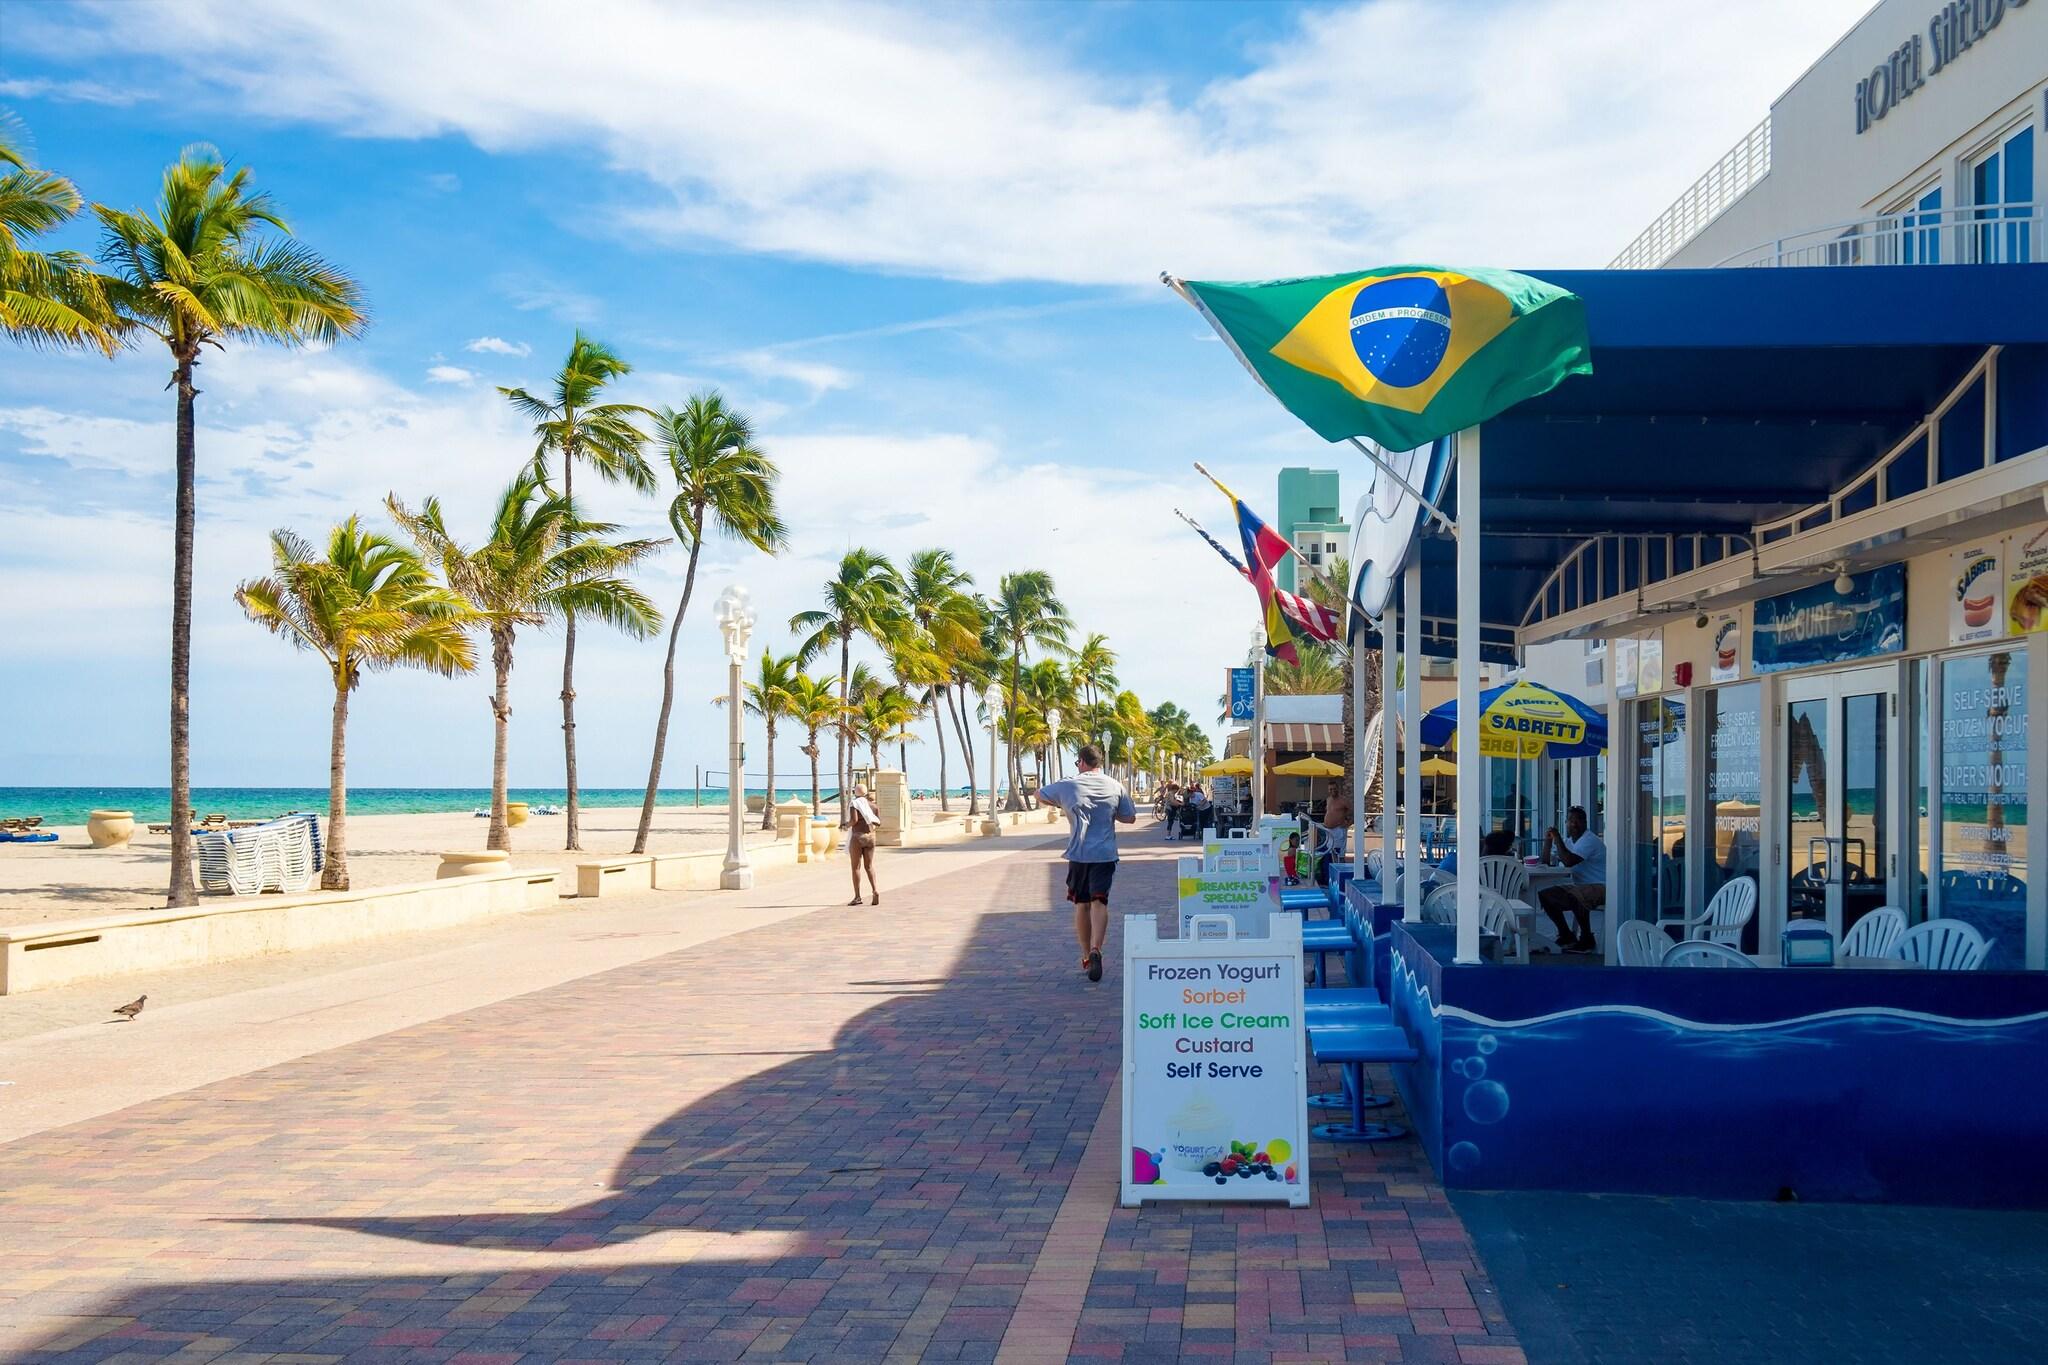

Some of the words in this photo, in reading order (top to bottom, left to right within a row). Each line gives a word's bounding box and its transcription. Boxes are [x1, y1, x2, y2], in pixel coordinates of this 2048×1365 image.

[1855, 34, 1925, 135] HOTEL
[1928, 0, 2028, 76] SHELD
[1352, 311, 1386, 326] ORDEM
[1397, 309, 1448, 325] PROGRESSO
[1956, 557, 1996, 602] SABRETT
[1505, 698, 1559, 707] SABRETT
[1953, 686, 2022, 712] SELF-SERVE
[1491, 714, 1580, 739] SABRETT
[1943, 718, 1986, 738] FROZEN
[1711, 733, 1736, 748] FROZEN
[1709, 772, 1730, 788] SUPER
[1943, 766, 1977, 787] SUPER
[1716, 816, 1740, 832] PROTEIN
[1742, 816, 1758, 832] BARS
[1960, 827, 1990, 840] PROTEIN
[1991, 828, 2012, 841] BARS
[1197, 881, 1263, 892] BREAKFAST
[1203, 892, 1258, 903] SPECIALS
[1149, 965, 1211, 980] Frozen
[1217, 963, 1281, 983] Yogurt
[1183, 988, 1246, 1004] Sorbet
[1139, 1013, 1177, 1029] Soft
[1182, 1013, 1214, 1029] Ice
[1220, 1012, 1290, 1028] Cream
[1175, 1037, 1254, 1053] Custard
[1166, 1062, 1202, 1078] Self
[1208, 1062, 1263, 1078] Serve
[1173, 1145, 1204, 1154] YOGURT
